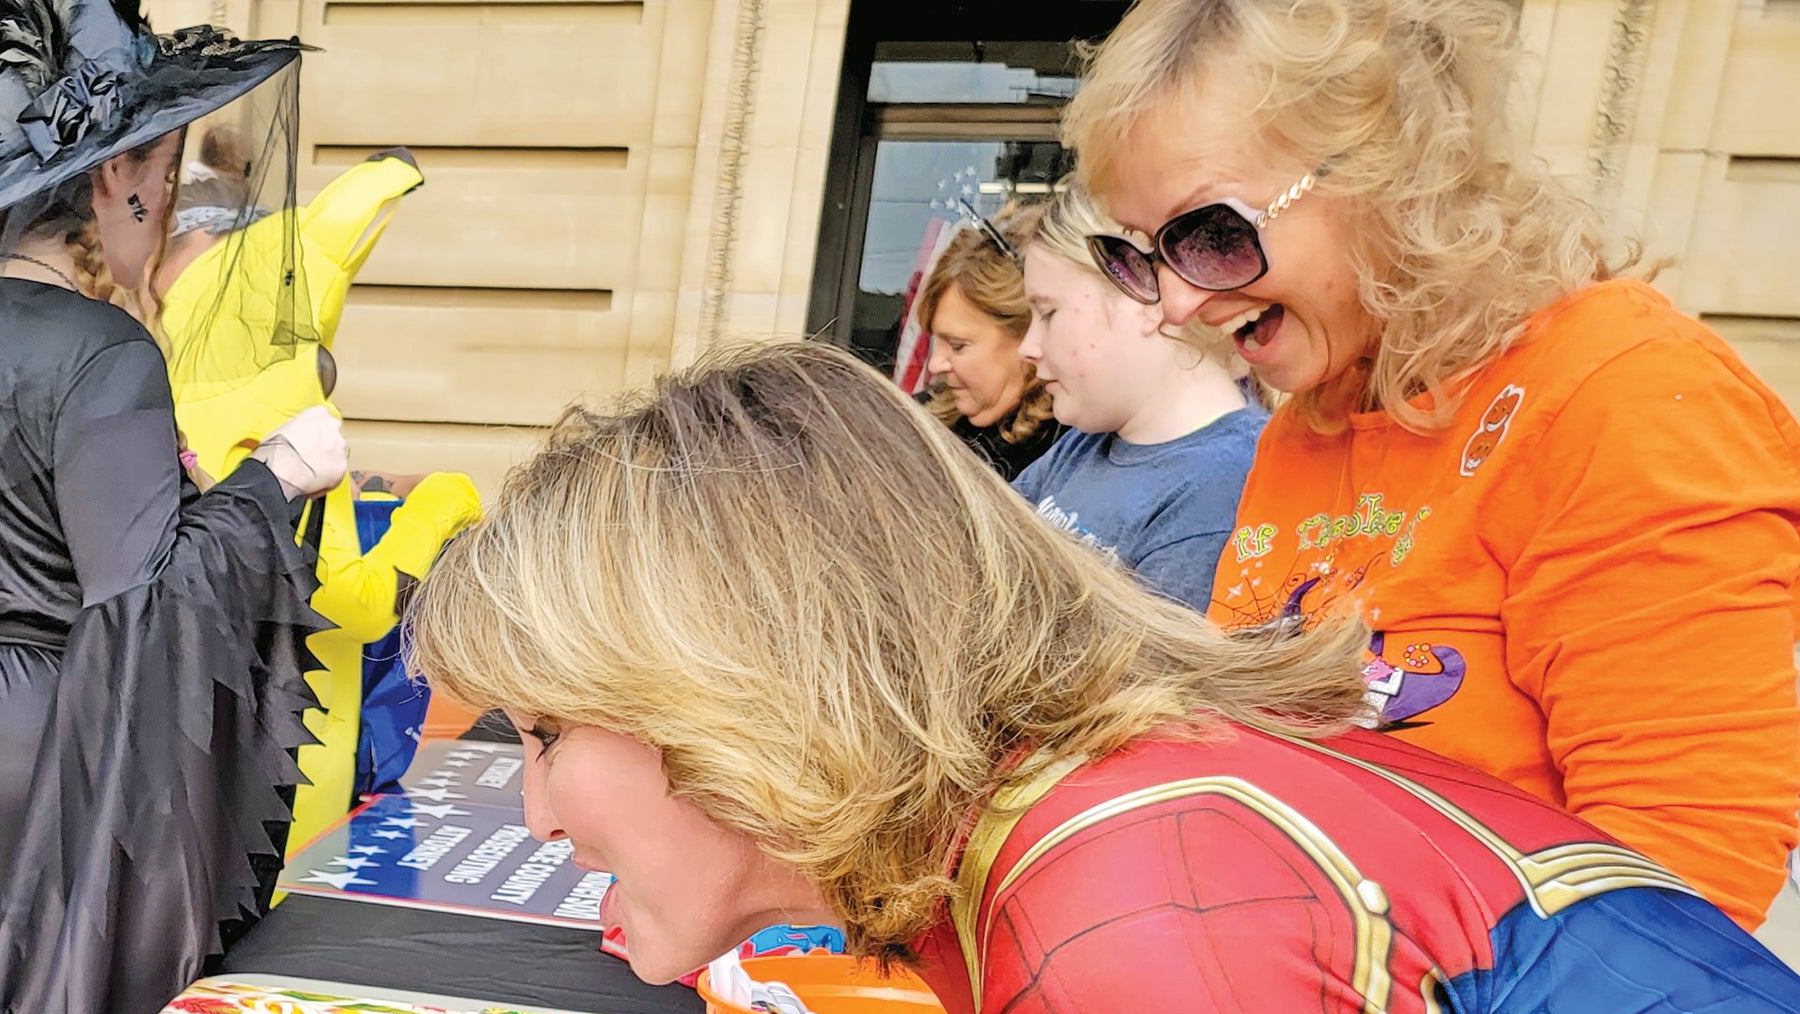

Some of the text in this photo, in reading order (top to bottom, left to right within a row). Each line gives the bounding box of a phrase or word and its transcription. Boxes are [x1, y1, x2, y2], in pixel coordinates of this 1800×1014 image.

[397, 823, 473, 871] ATTORNEY
[444, 824, 530, 886] PROSECUTING
[487, 863, 558, 905] COUNTY
